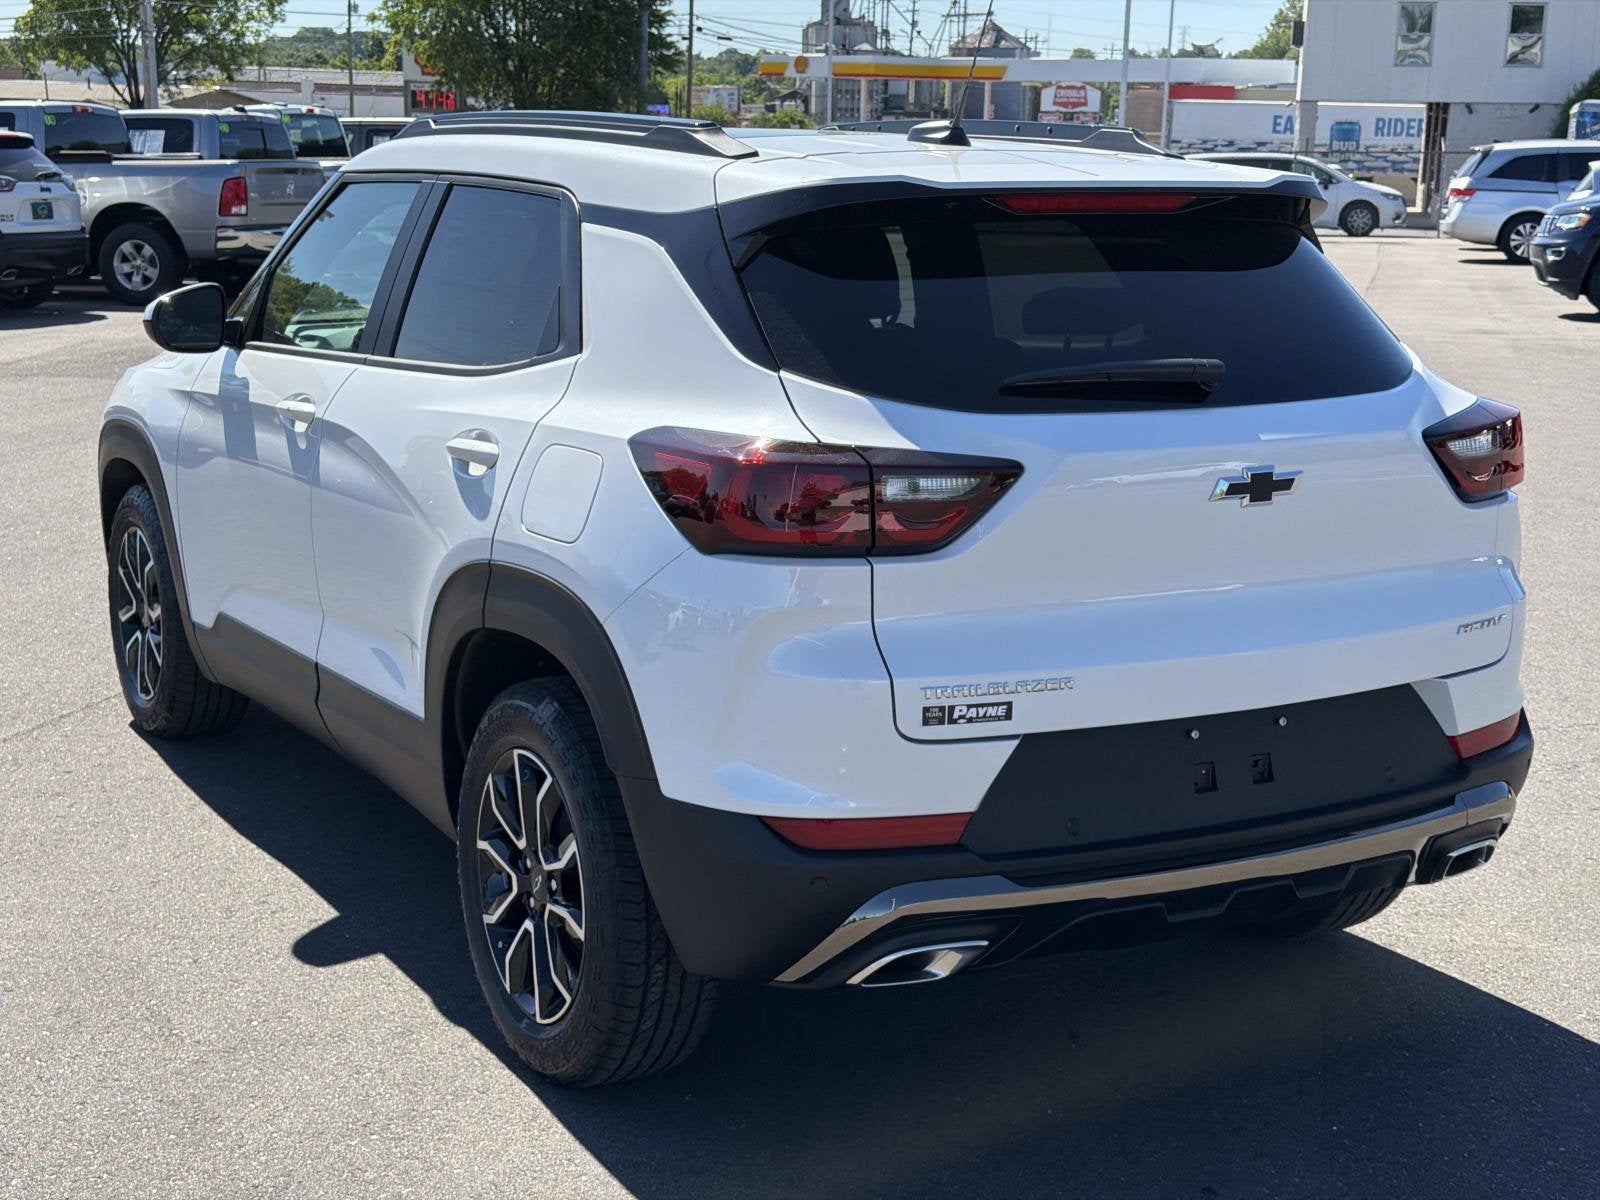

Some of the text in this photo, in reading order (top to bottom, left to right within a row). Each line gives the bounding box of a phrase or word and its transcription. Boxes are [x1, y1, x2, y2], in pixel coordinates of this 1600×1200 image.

[1271, 115, 1295, 135] EA
[1332, 140, 1357, 151] BUD
[920, 676, 1074, 700] TRAILBLAZER
[952, 704, 1008, 719] PAYNE
